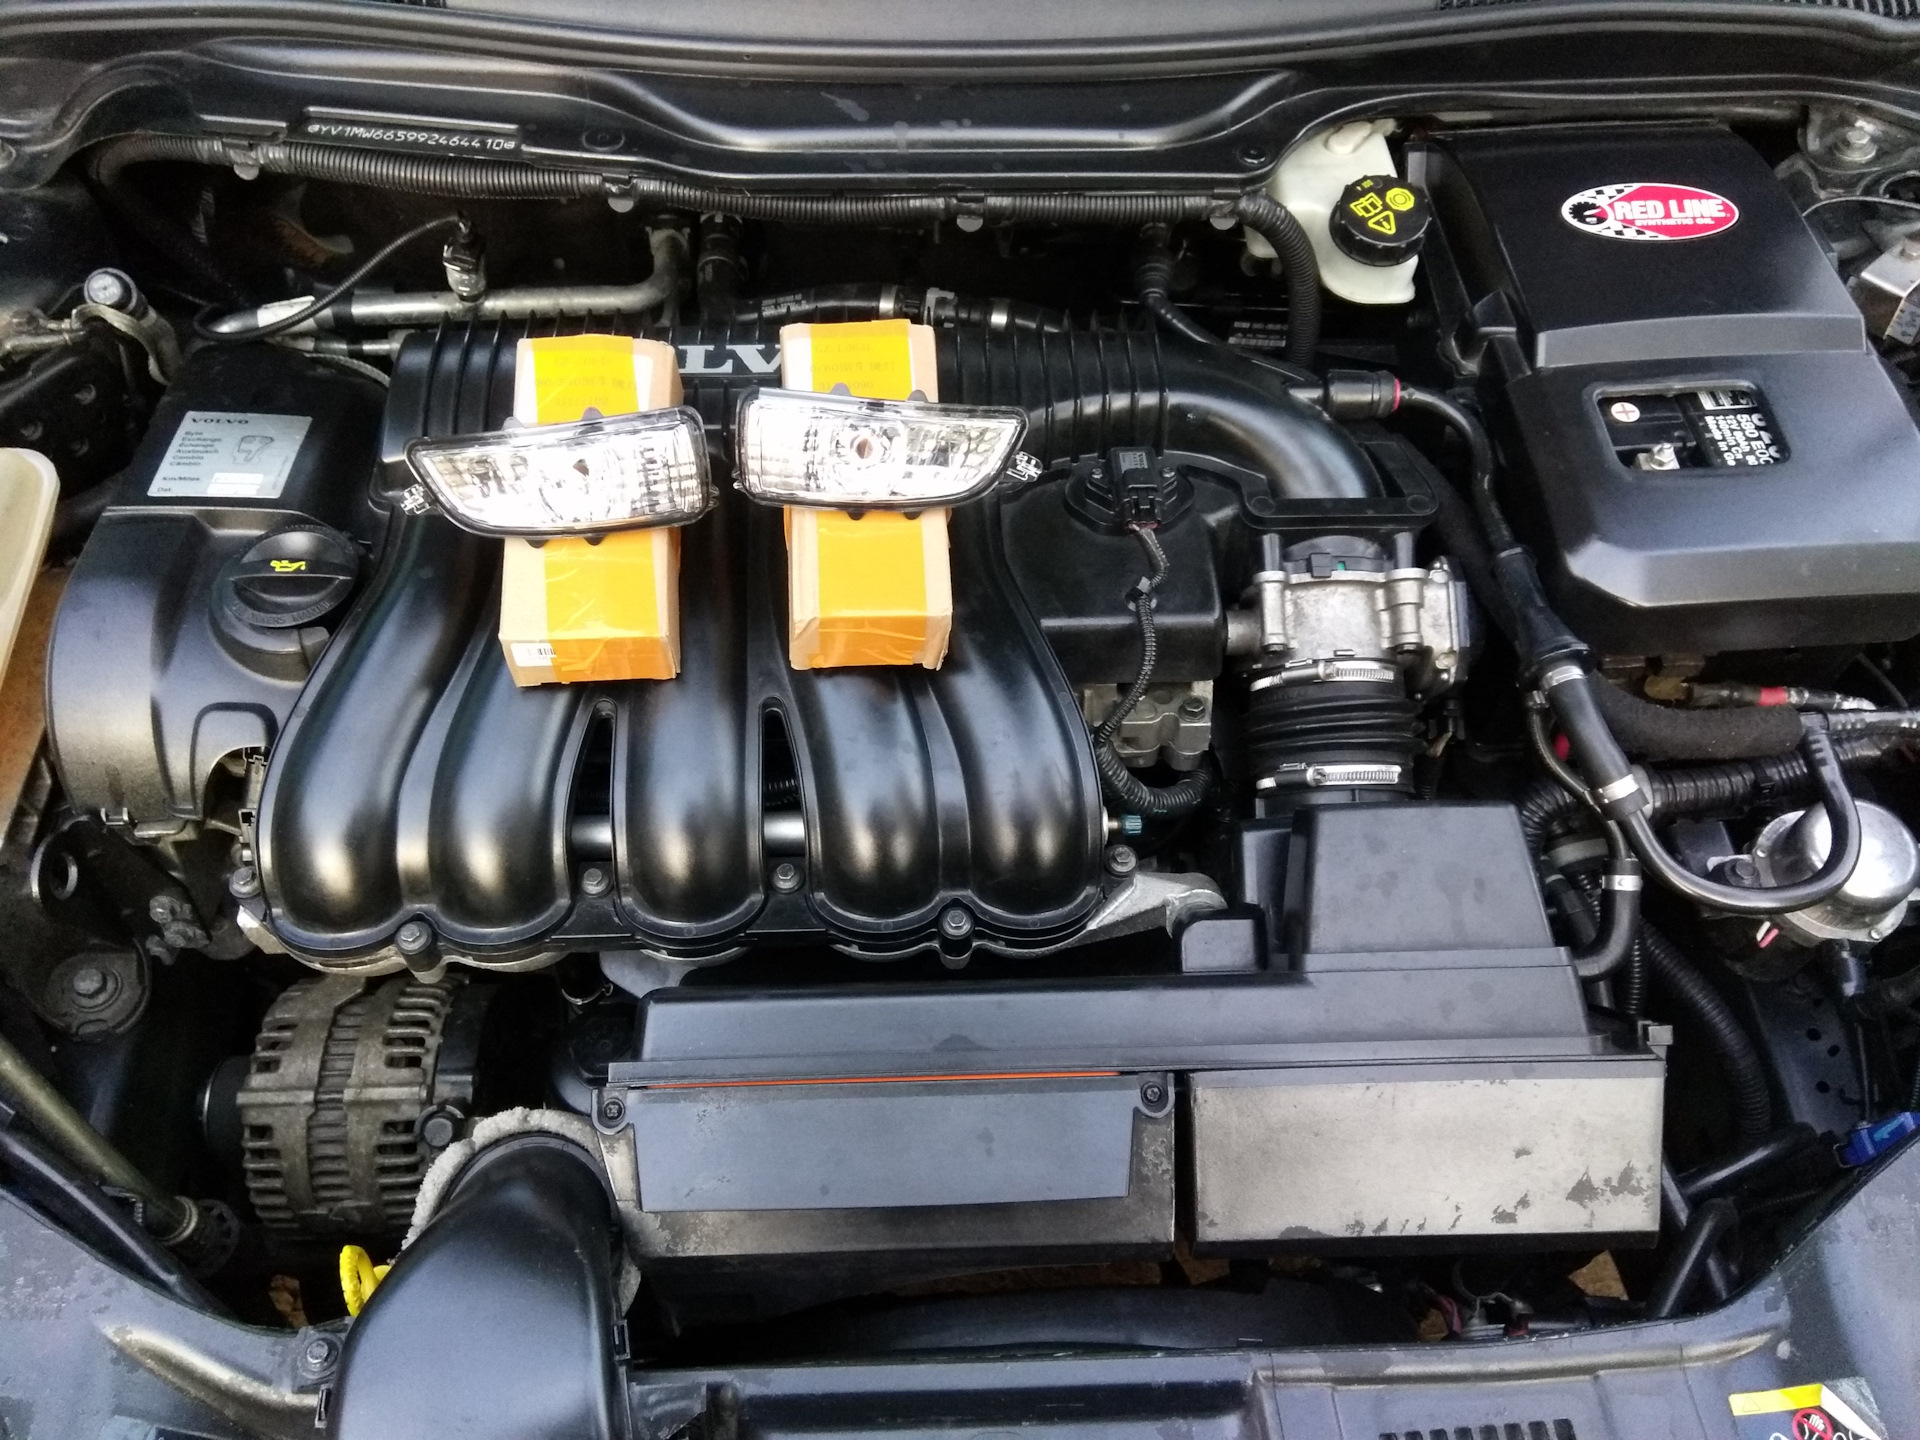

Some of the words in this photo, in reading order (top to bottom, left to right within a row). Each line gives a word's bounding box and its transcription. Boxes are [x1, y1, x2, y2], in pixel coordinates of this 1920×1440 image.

[1613, 200, 1665, 220] RED
[1669, 199, 1726, 217] LINE
[1635, 218, 1693, 226] SYNTHETIC
[191, 417, 249, 425] VOLVO
[1703, 415, 1724, 441] Made
[1724, 414, 1741, 430] 12V
[1735, 413, 1760, 438] 580
